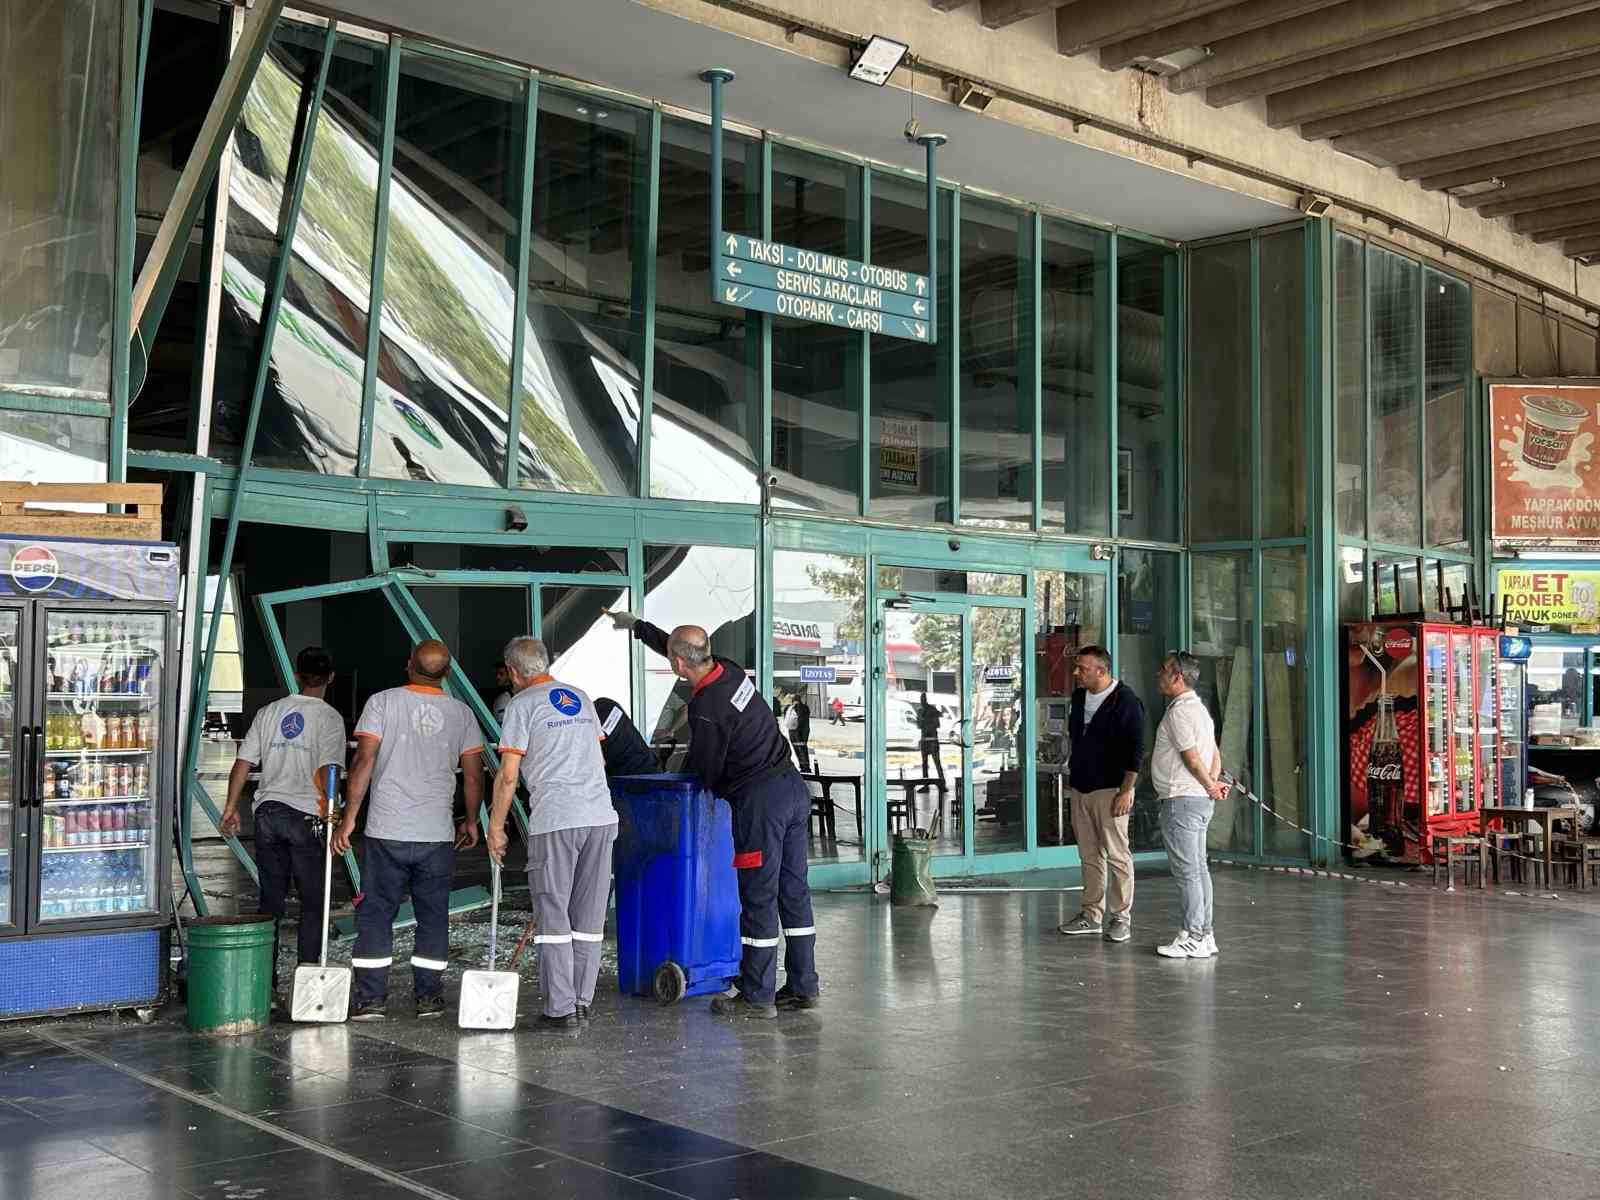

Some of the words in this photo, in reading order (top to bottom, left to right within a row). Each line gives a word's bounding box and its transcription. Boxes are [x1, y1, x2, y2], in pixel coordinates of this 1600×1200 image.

[748, 240, 784, 265] TAKSİ
[797, 251, 848, 281] DOLMUŞ
[776, 270, 821, 297] SERVİS
[823, 280, 882, 308] ARAÇLARI
[776, 294, 834, 322] OTOPARK
[847, 309, 882, 333] ÇARŞI
[1523, 498, 1575, 513] YAPRAK
[1511, 515, 1563, 532] MEŞHUR
[14, 564, 56, 574] PEPSI
[1533, 574, 1568, 592] ET
[1506, 610, 1550, 620] TAVUK
